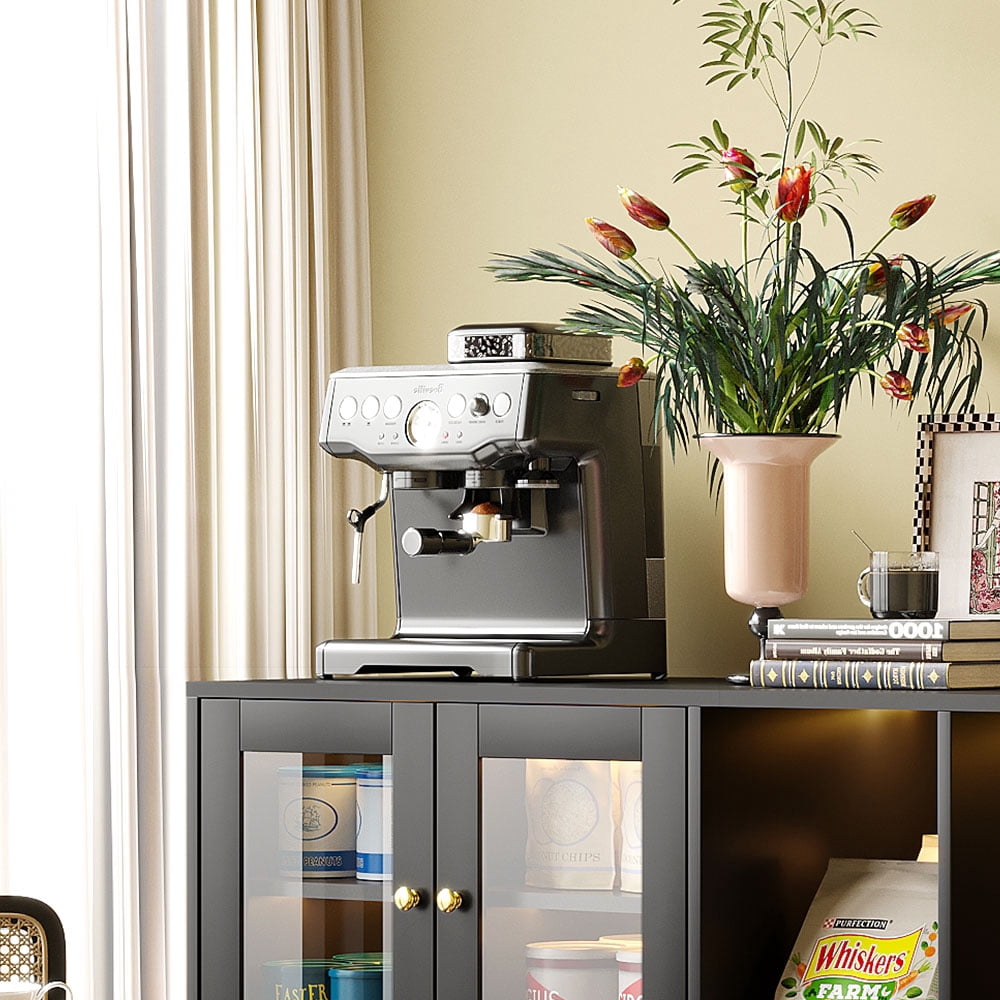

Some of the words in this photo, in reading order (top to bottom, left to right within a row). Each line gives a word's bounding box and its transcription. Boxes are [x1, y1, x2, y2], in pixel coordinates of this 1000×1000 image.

[562, 852, 601, 863] CHIPS
[835, 919, 887, 929] PURFECTION
[815, 940, 906, 974] Whiskers
[816, 983, 882, 1000] FARM
